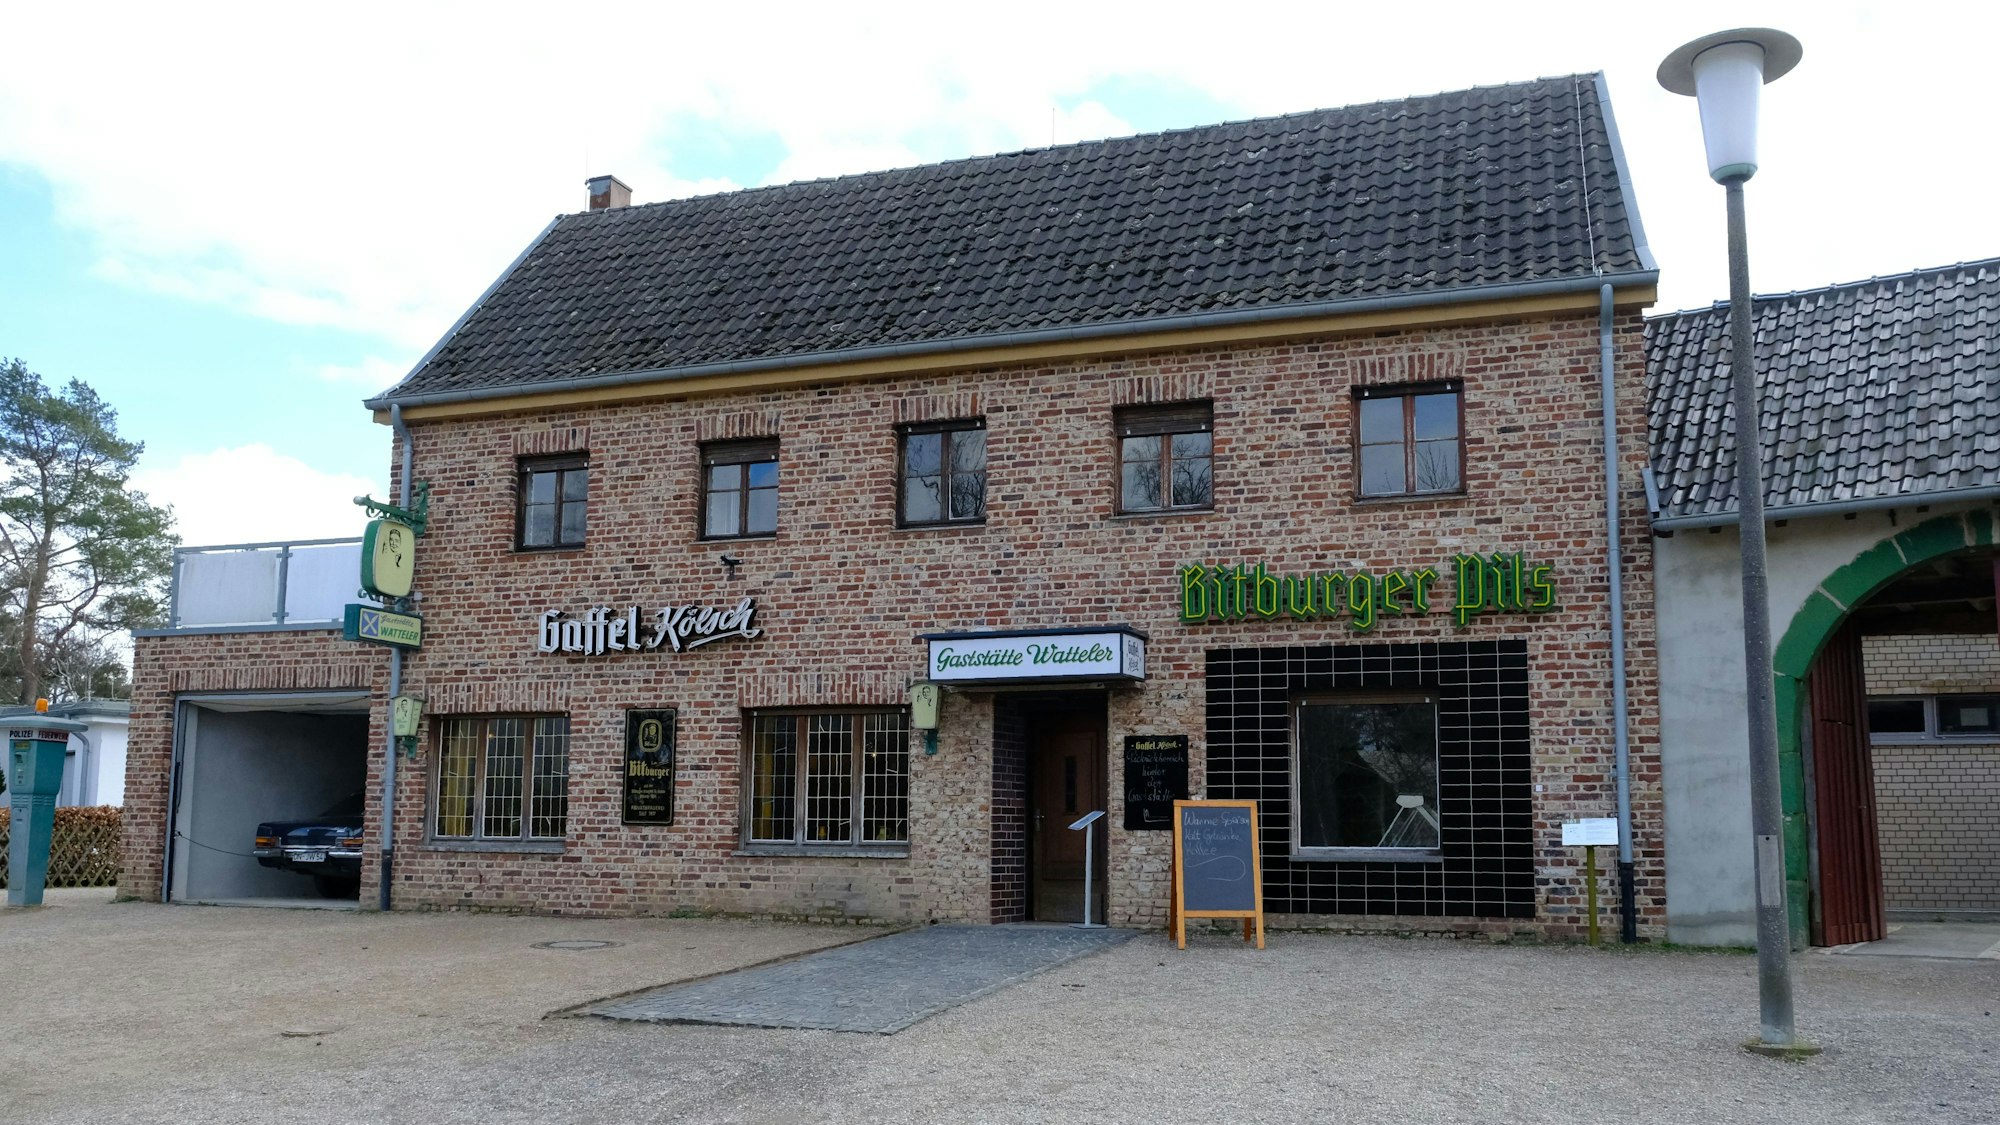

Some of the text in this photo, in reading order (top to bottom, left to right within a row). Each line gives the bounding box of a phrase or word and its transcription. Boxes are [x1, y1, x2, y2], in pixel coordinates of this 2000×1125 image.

[1181, 550, 1556, 634] Bitburger Pils
[381, 626, 419, 641] WATTELER
[538, 597, 764, 656] Gaffel Kölsch
[937, 643, 1113, 672] Gaststätte Watteler
[9, 730, 33, 738] POLIZEI
[1135, 741, 1156, 751] Gaffel
[628, 760, 670, 779] Bitburger
[1184, 811, 1218, 826] Warme
